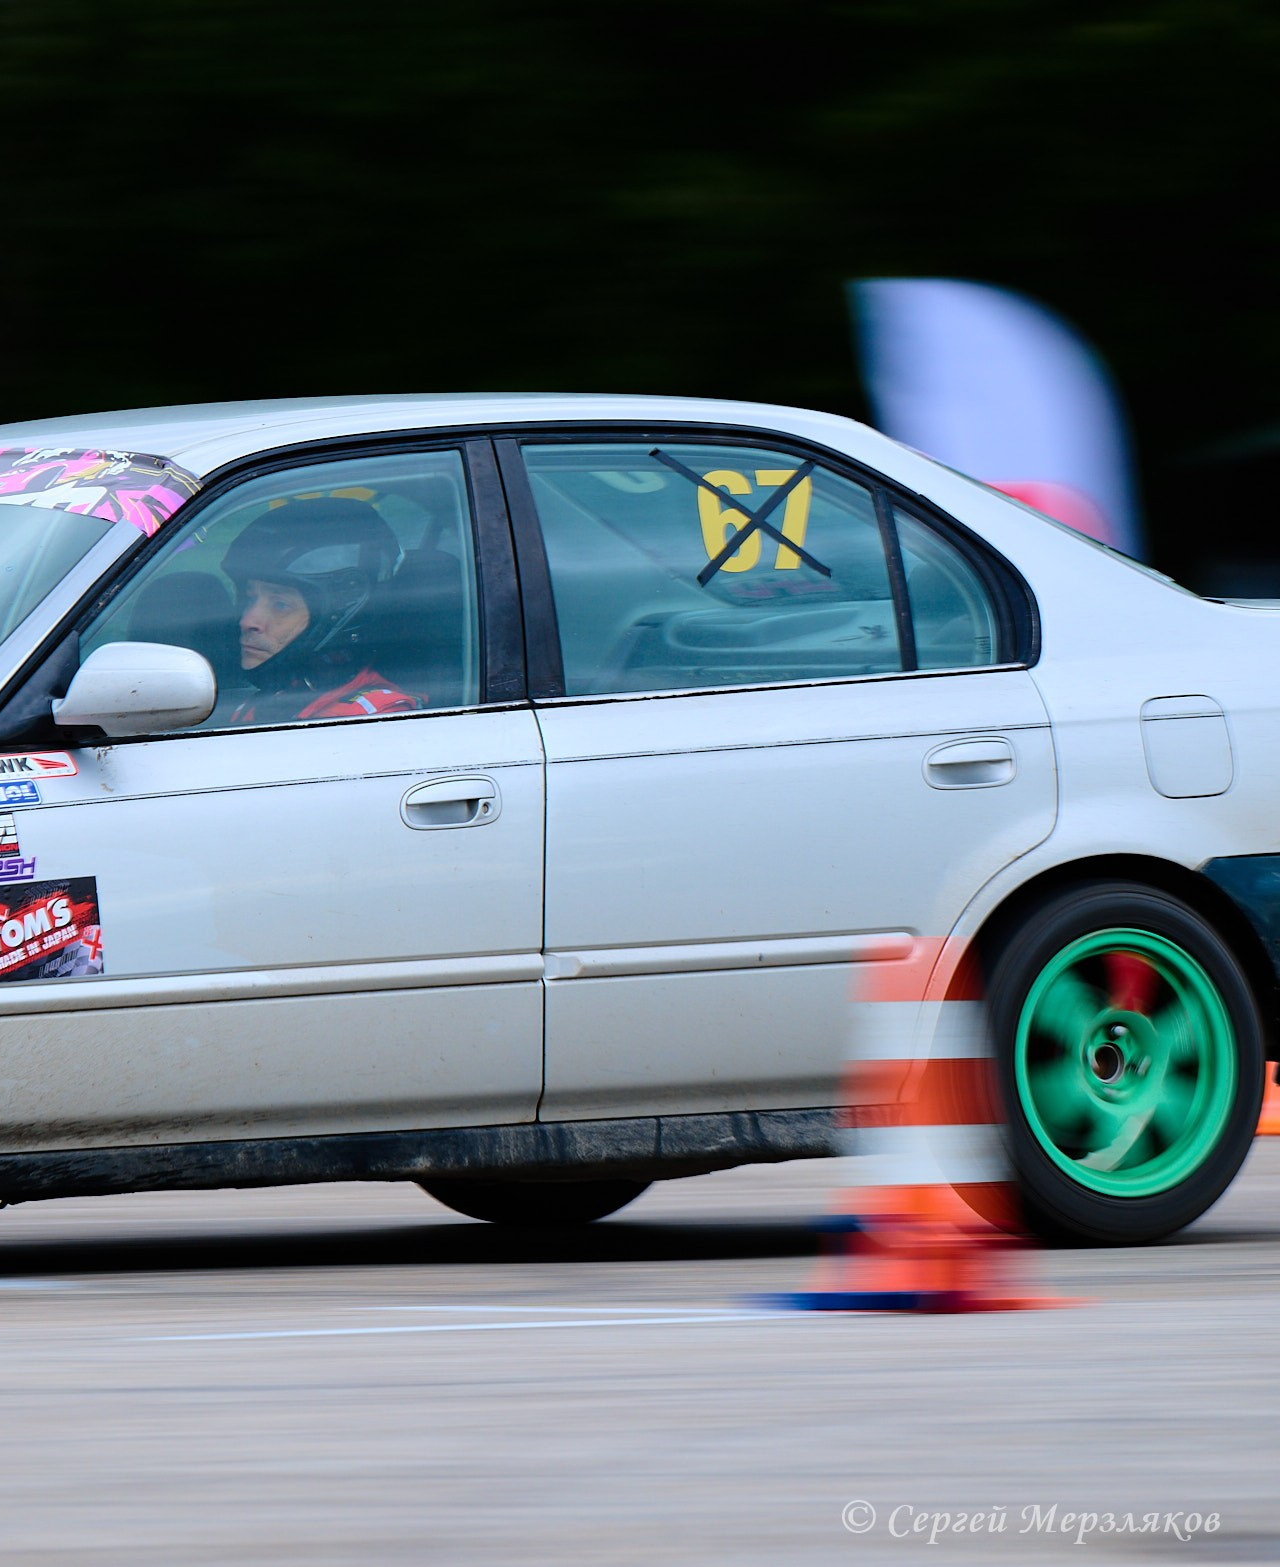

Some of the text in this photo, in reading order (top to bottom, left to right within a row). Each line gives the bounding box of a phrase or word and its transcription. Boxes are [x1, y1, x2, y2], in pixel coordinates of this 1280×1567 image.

[697, 470, 812, 573] 67
[26, 940, 41, 956] IN
[42, 924, 79, 950] JAPAN
